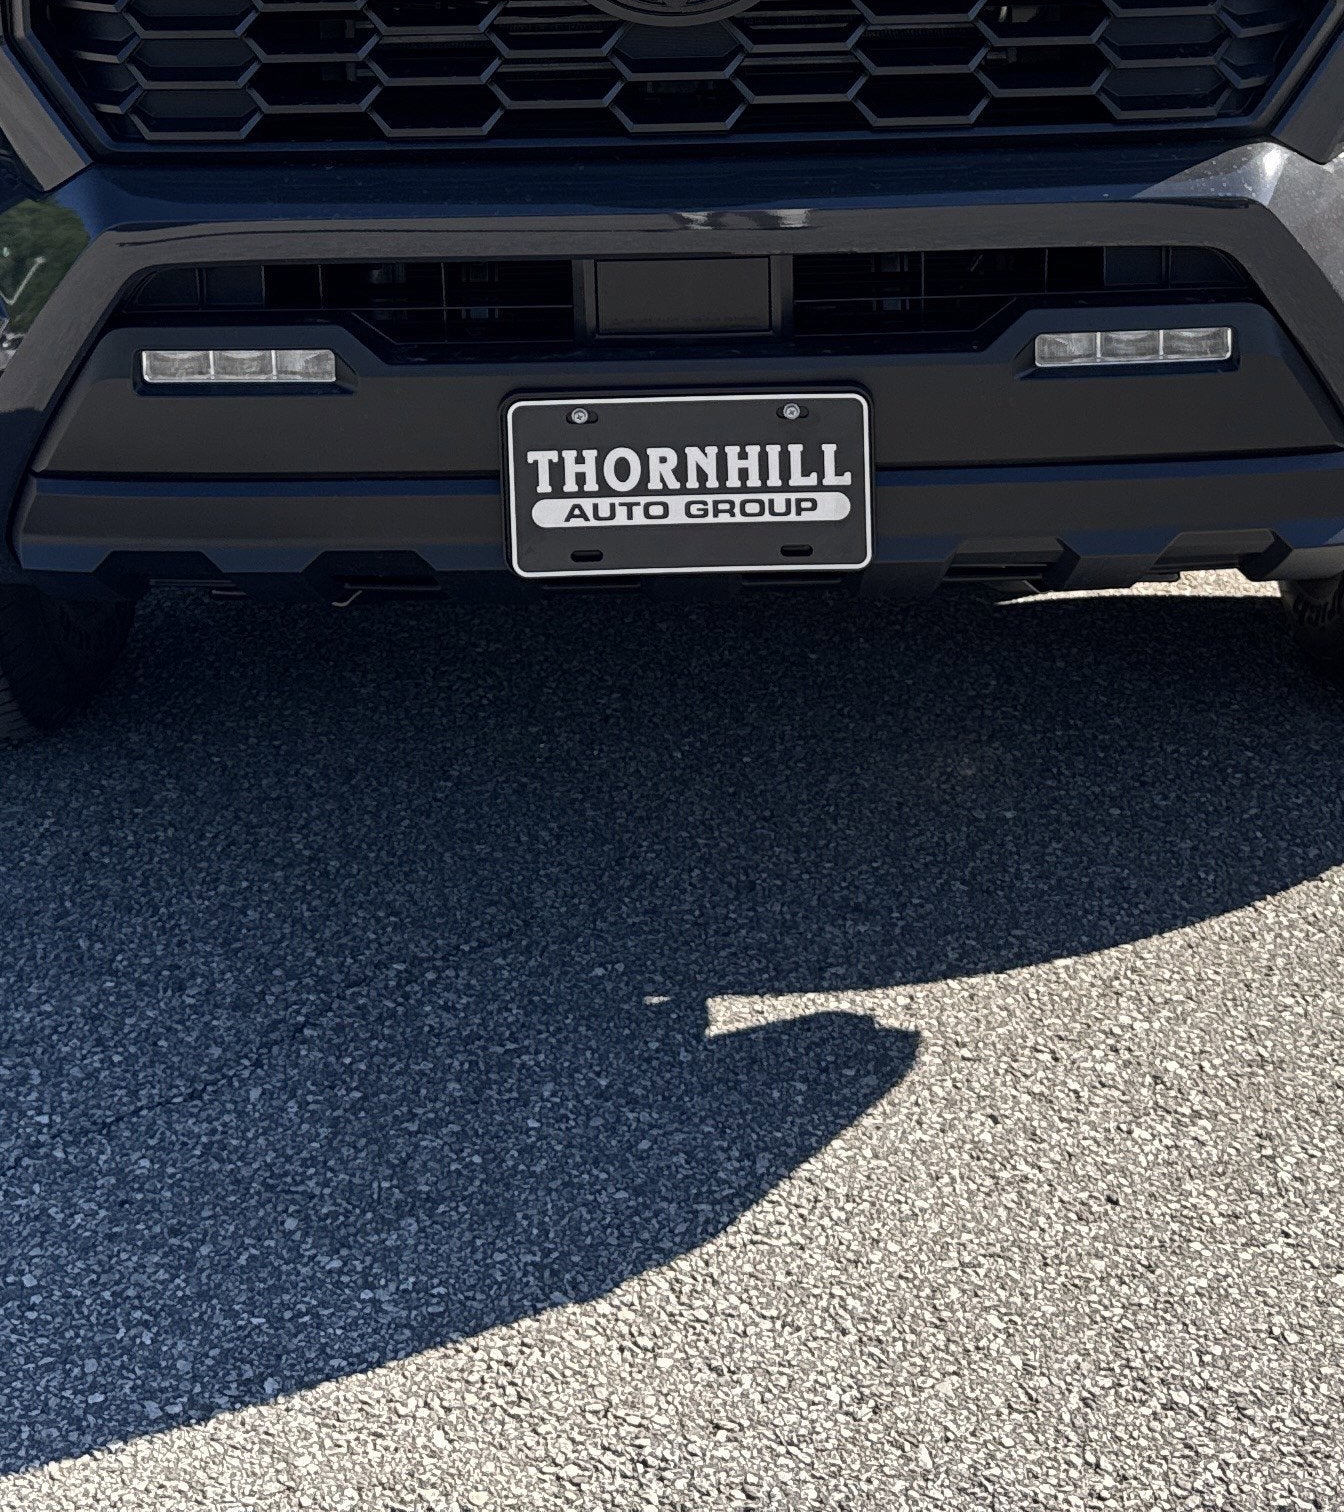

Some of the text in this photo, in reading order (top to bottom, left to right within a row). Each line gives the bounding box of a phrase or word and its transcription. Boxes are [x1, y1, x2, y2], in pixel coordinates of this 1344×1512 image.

[527, 443, 852, 493] THORNHILL
[564, 498, 818, 522] AUTO GROUP
